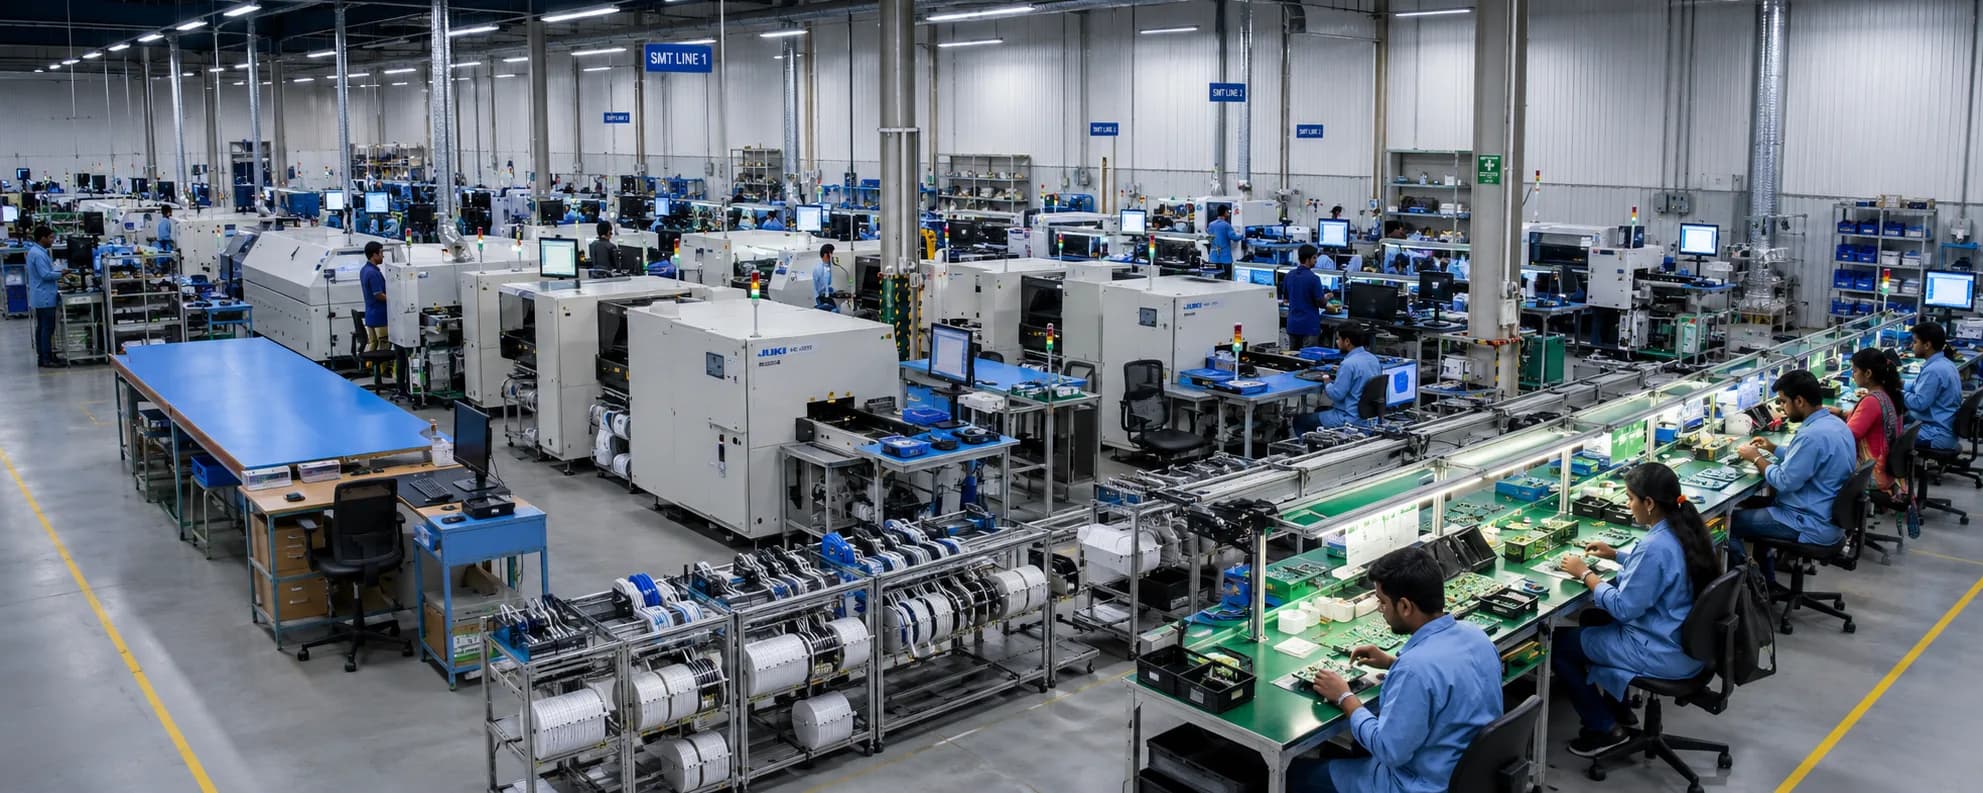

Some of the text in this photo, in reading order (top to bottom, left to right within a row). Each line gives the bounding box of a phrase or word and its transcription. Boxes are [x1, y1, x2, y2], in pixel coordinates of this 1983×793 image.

[650, 51, 707, 65] SMT LINE 1
[757, 346, 787, 357] JUKI
